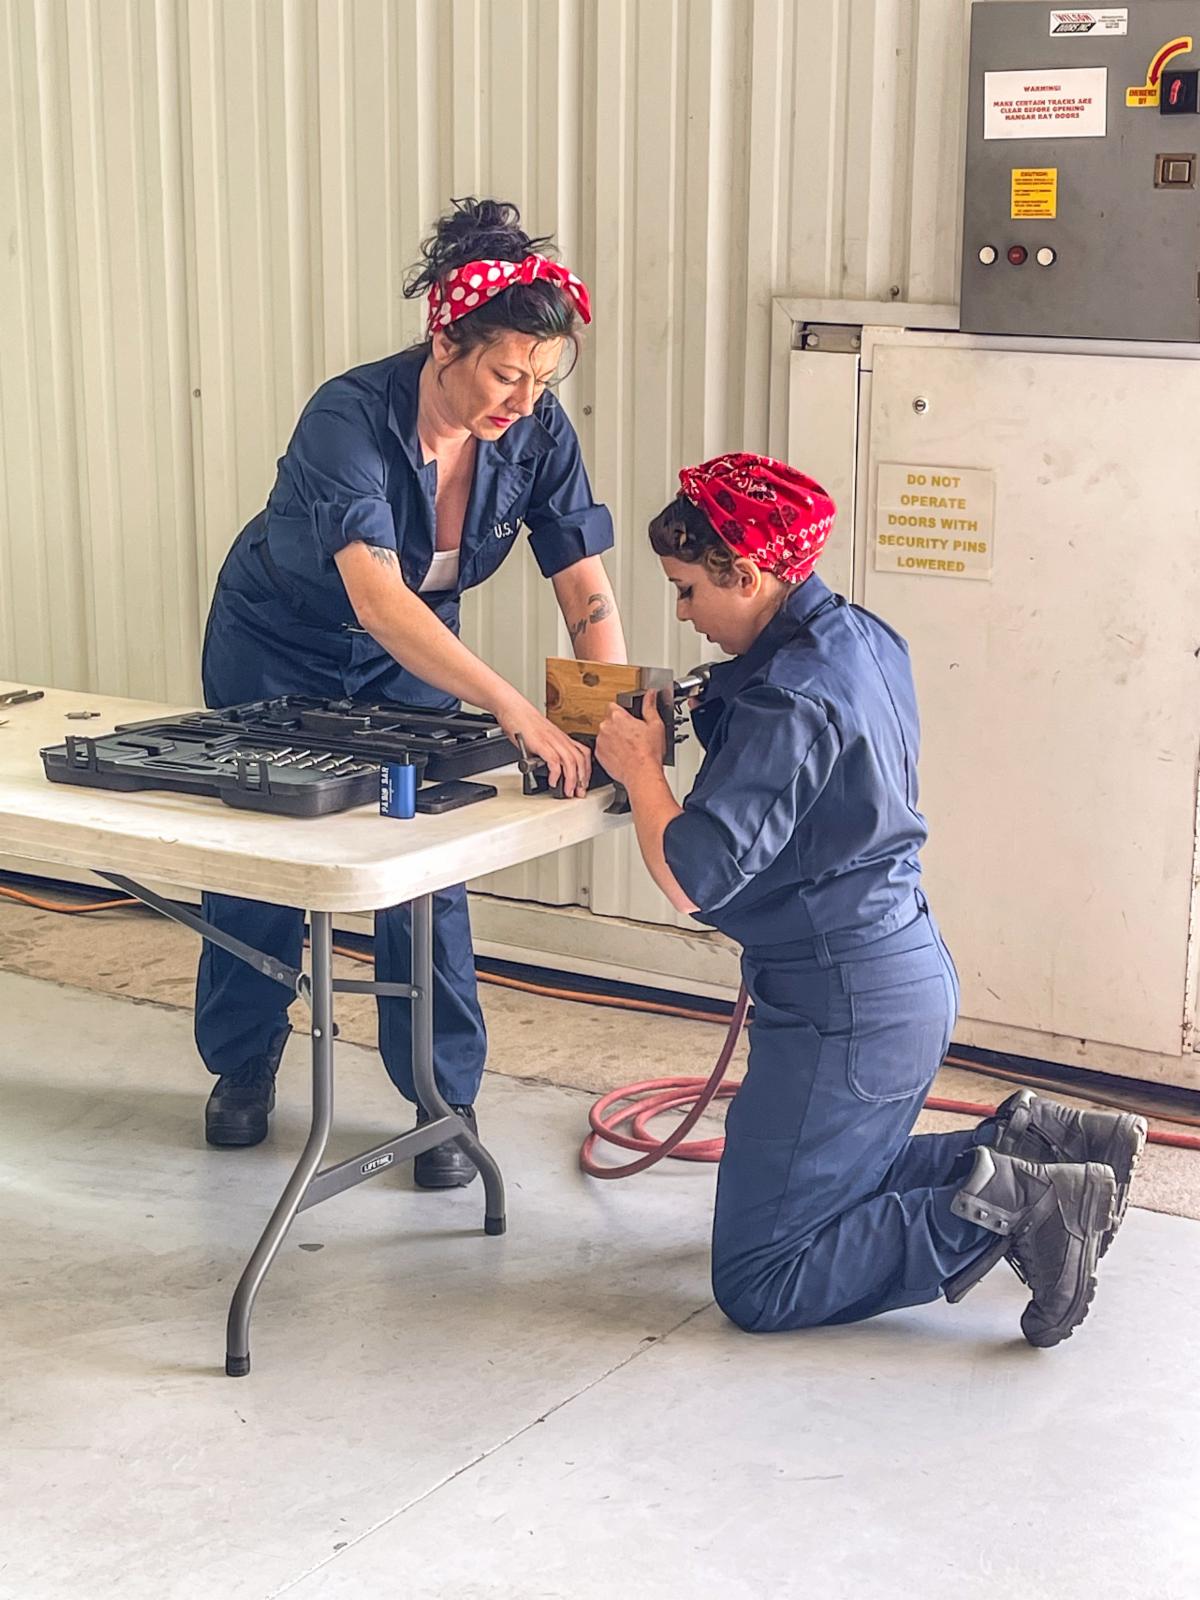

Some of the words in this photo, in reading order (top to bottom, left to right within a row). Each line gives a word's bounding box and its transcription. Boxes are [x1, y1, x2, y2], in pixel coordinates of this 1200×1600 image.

[906, 474, 927, 486] DO
[931, 475, 961, 488] NOT
[900, 494, 967, 510] OPERATE
[493, 522, 514, 539] U.S.
[887, 514, 937, 529] DOORS
[940, 518, 978, 532] WITH
[878, 534, 949, 550] SECURITY
[953, 540, 987, 553] PINS
[897, 556, 966, 573] LOWERED
[381, 766, 389, 785] BAR
